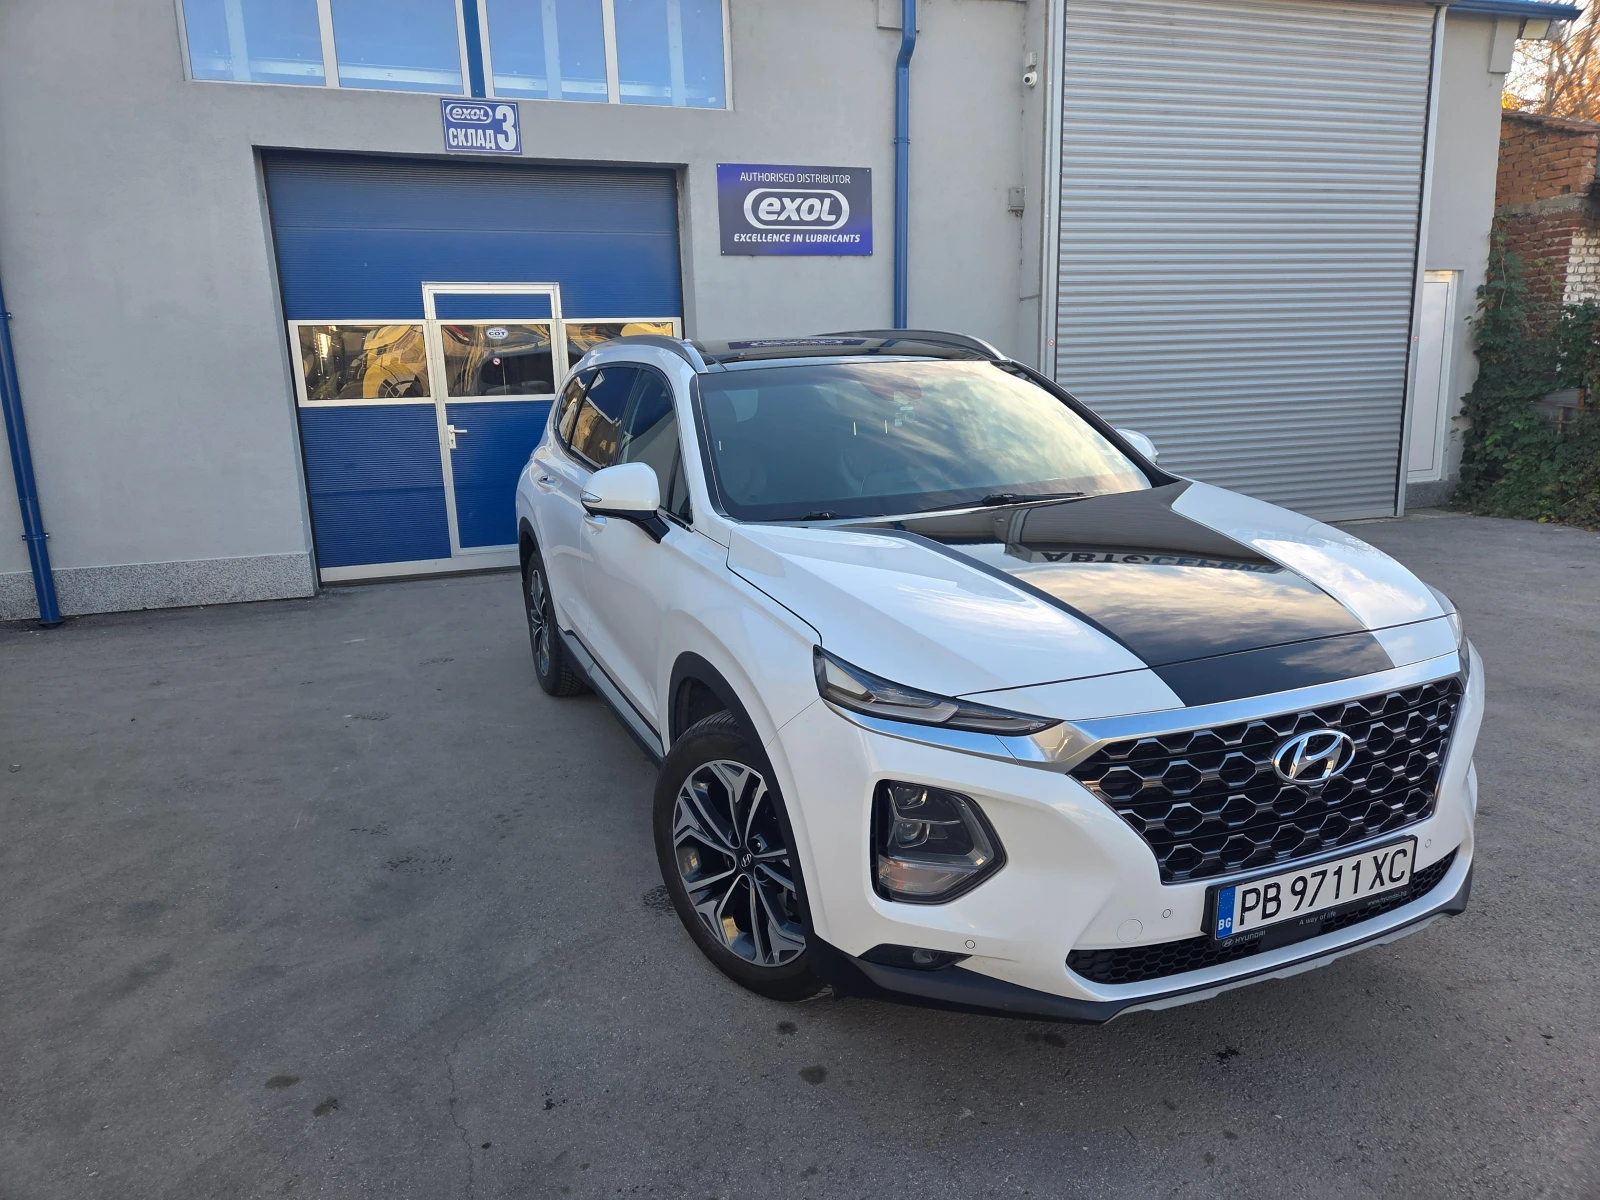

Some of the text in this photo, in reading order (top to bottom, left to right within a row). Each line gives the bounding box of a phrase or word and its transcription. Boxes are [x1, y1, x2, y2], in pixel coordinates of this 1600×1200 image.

[495, 105, 517, 150] 3
[449, 128, 495, 149] СКЛАД
[740, 171, 851, 184] AUTHORISED DISTRIBUTOR
[734, 233, 860, 243] EXCELLENCE IN LUBRICANTS
[1239, 848, 1407, 926] PB 9711 XC
[1218, 917, 1232, 930] BG
[1306, 916, 1318, 925] way
[1235, 930, 1266, 943] HYUNDAI
